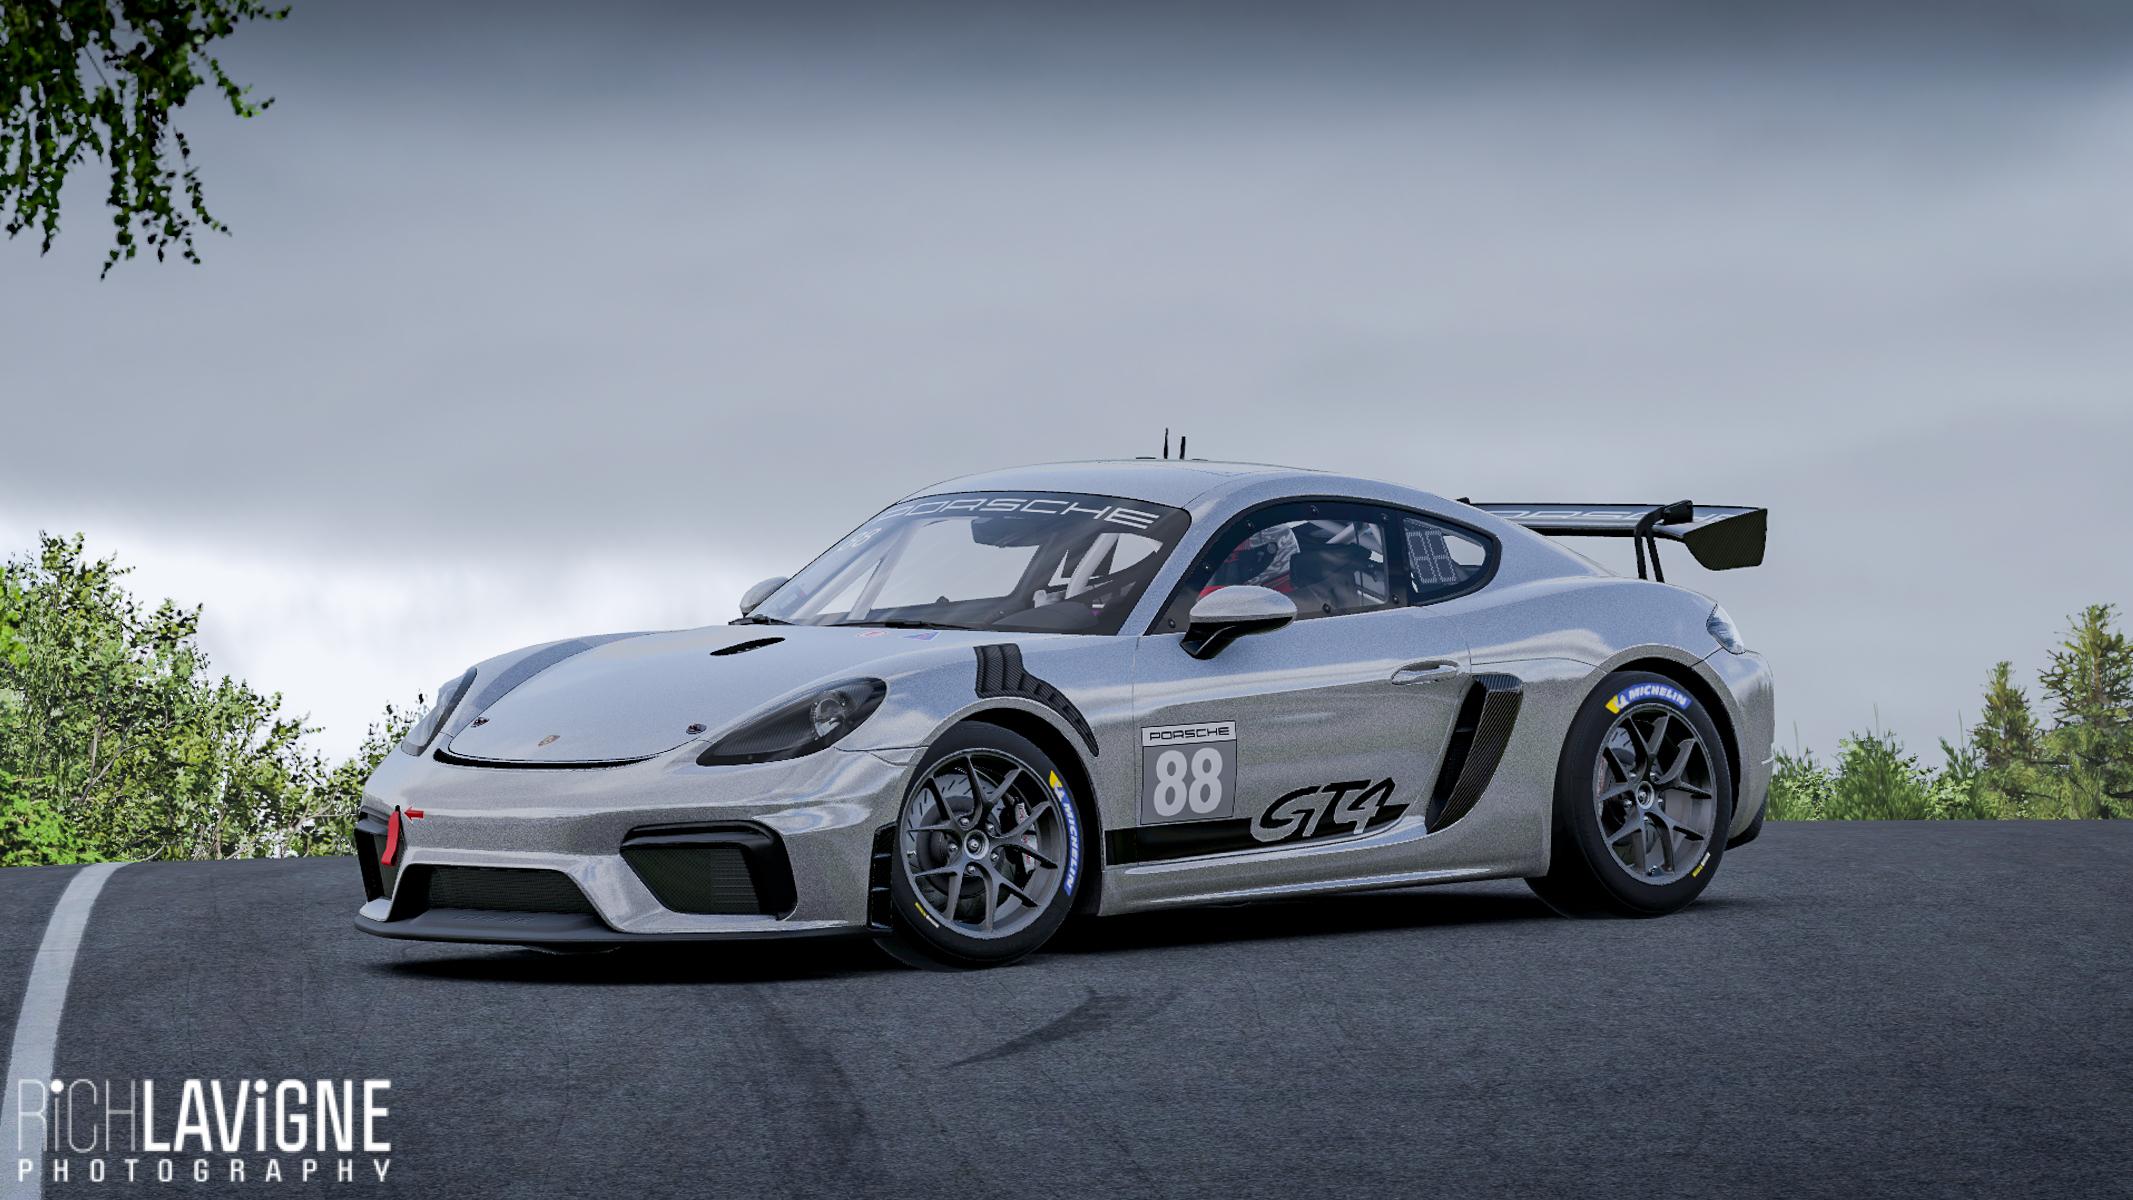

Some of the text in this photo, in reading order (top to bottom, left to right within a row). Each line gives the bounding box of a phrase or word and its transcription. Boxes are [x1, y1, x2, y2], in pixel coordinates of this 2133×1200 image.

[870, 498, 1160, 530] PORSCHE
[1628, 684, 1688, 705] MICHELIN
[1149, 726, 1231, 741] PORSCHE
[1153, 747, 1223, 817] 88
[1250, 777, 1396, 842] GT4
[1063, 802, 1079, 889] MICHELIN
